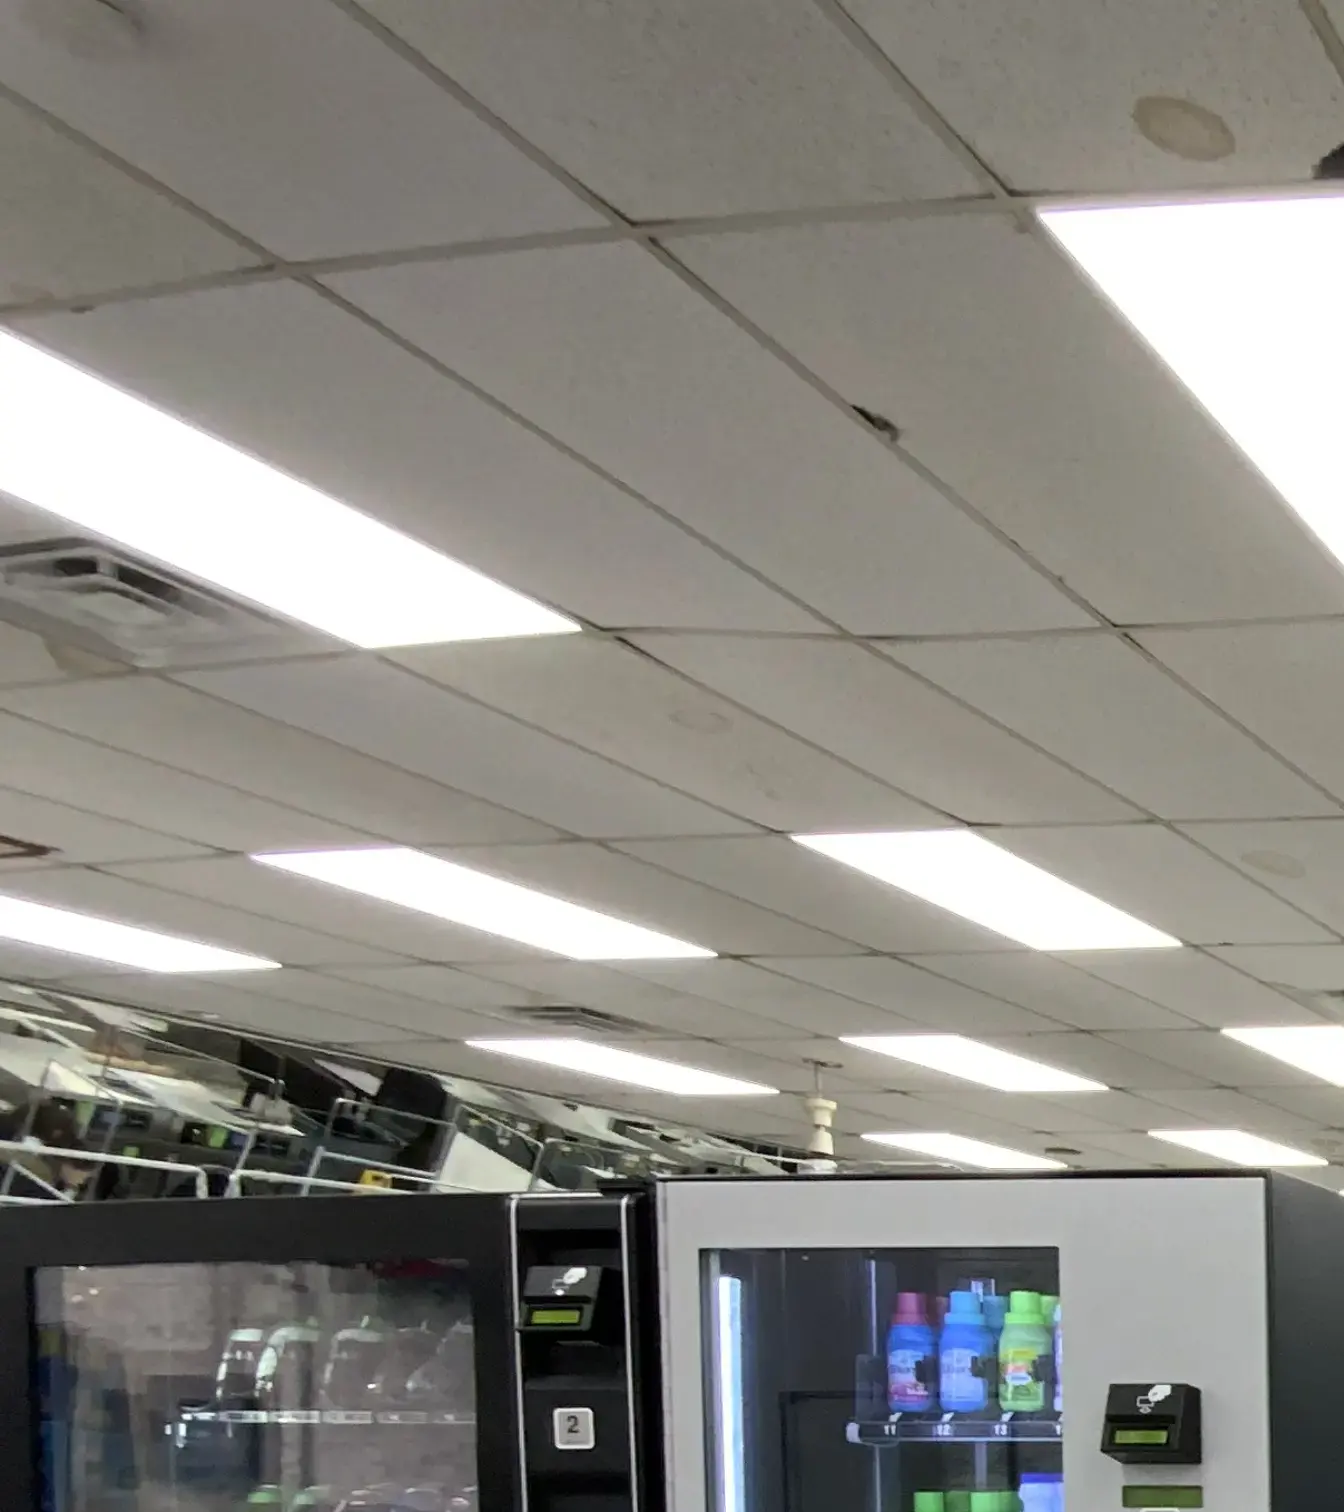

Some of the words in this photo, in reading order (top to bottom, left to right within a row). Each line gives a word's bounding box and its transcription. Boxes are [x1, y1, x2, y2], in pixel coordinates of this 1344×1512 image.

[567, 1415, 579, 1434] 2
[884, 1424, 897, 1435] 11
[937, 1424, 951, 1436] 12
[994, 1424, 1008, 1435] 13
